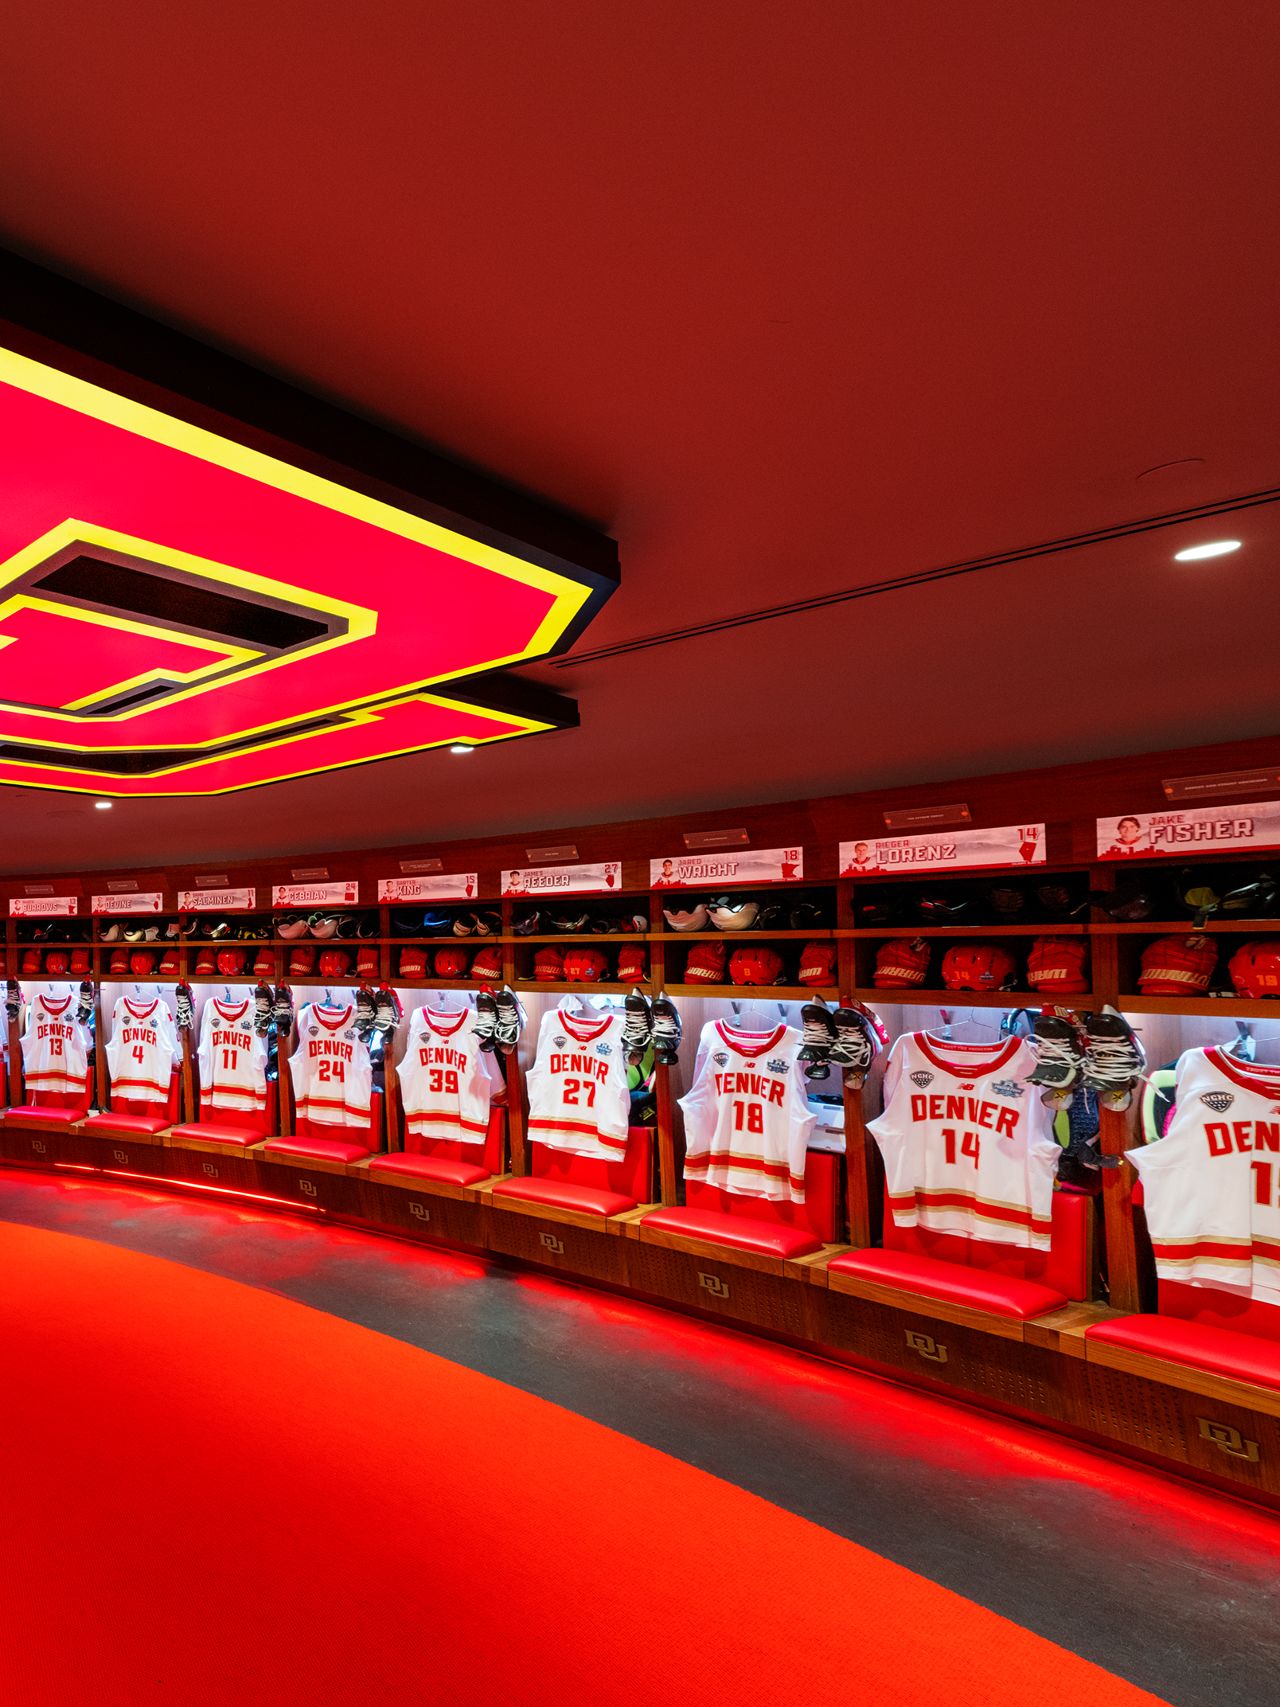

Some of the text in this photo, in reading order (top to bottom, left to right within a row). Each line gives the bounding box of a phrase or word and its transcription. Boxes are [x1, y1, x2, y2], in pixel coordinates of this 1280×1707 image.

[1149, 814, 1185, 826] JAKE
[1018, 827, 1038, 841] 14
[1149, 818, 1255, 845] FISHER
[875, 839, 910, 849] RIEGER
[678, 858, 703, 866] JARED
[783, 850, 798, 861] 18
[876, 844, 957, 865] LORENZ
[604, 864, 618, 874] 27
[678, 862, 740, 879] WRIGHT
[465, 875, 476, 884] 15
[523, 875, 571, 889] REEDER
[288, 891, 328, 901] CEBRIAN
[396, 885, 422, 896] KING
[37, 1023, 73, 1041] DENVER
[122, 1028, 157, 1048] DNVER
[212, 1031, 252, 1051] DENVER
[49, 1038, 63, 1056] 13
[131, 1045, 144, 1064] 4
[308, 1040, 353, 1063] DENVER
[222, 1049, 237, 1070] 11
[419, 1048, 467, 1074] DENVER
[550, 1053, 609, 1085] DENVER
[319, 1060, 345, 1082] 24
[429, 1069, 459, 1094] 39
[563, 1078, 596, 1108] 27
[733, 1100, 764, 1134] 18
[911, 1094, 1020, 1139] DENVER
[941, 1128, 980, 1170] 14
[1250, 1161, 1280, 1207] 1
